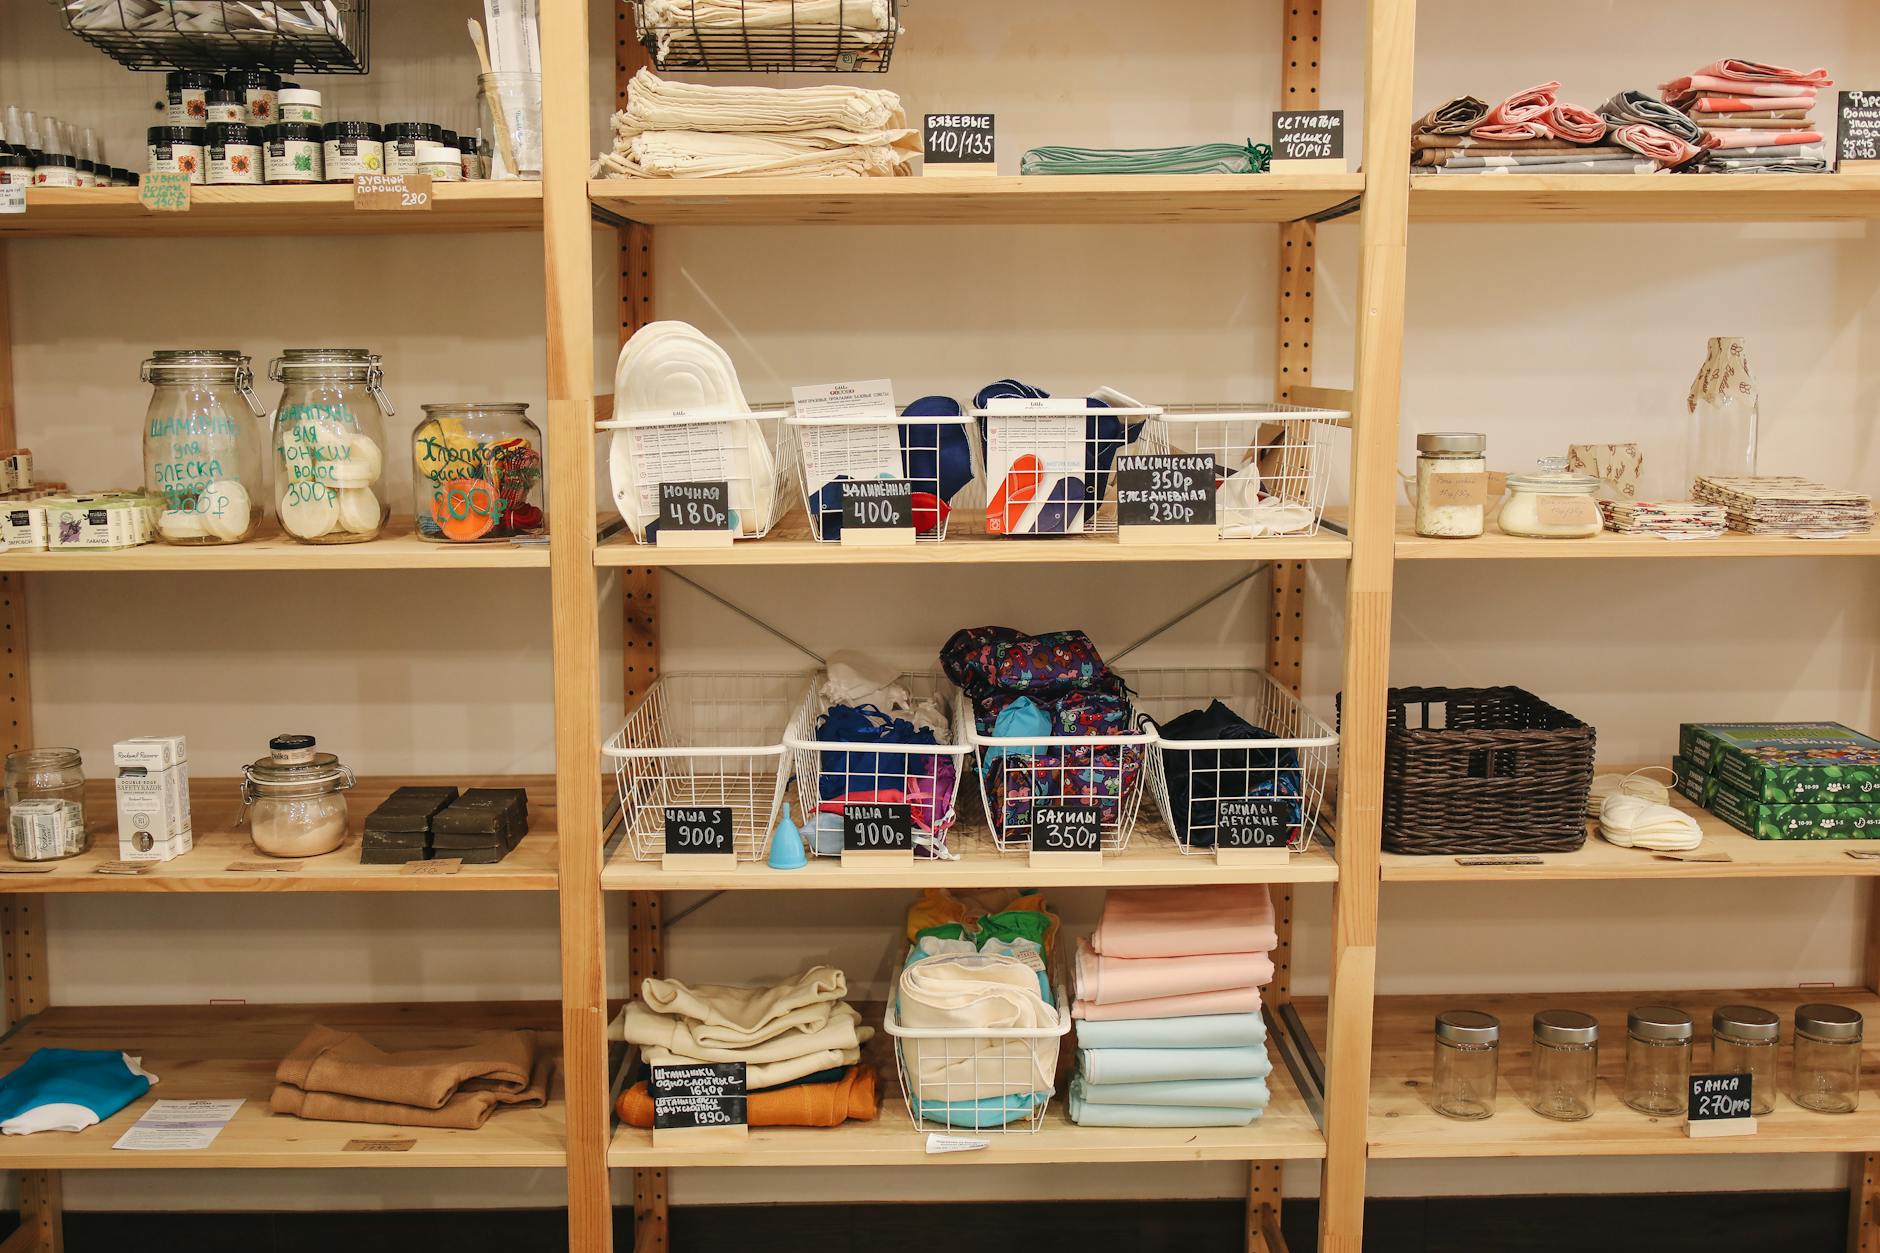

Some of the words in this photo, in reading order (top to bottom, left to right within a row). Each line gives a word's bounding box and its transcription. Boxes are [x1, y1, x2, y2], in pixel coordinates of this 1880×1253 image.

[928, 116, 990, 129] БЯЗЕВЫЕ
[929, 130, 993, 158] 110/135
[357, 185, 409, 193] ПОРОШОК
[401, 193, 427, 206] 280
[154, 460, 223, 482] БЛЕСКА
[1117, 457, 1214, 471] КЛАССИЧЕСКАЯ
[664, 485, 720, 500] НОЧНАЯ
[1118, 490, 1207, 504] ЕЖЕДНЕВНАЯ
[845, 806, 882, 820] ЧАША
[888, 807, 900, 820] L
[1220, 802, 1272, 815] БАХИЛЫ
[666, 810, 706, 823] ЧАША
[713, 810, 721, 824] S
[1036, 809, 1096, 825] БАХИЛЫ
[1219, 815, 1279, 828] ДЕТСКИЕ
[1694, 1077, 1739, 1095] БАНКА
